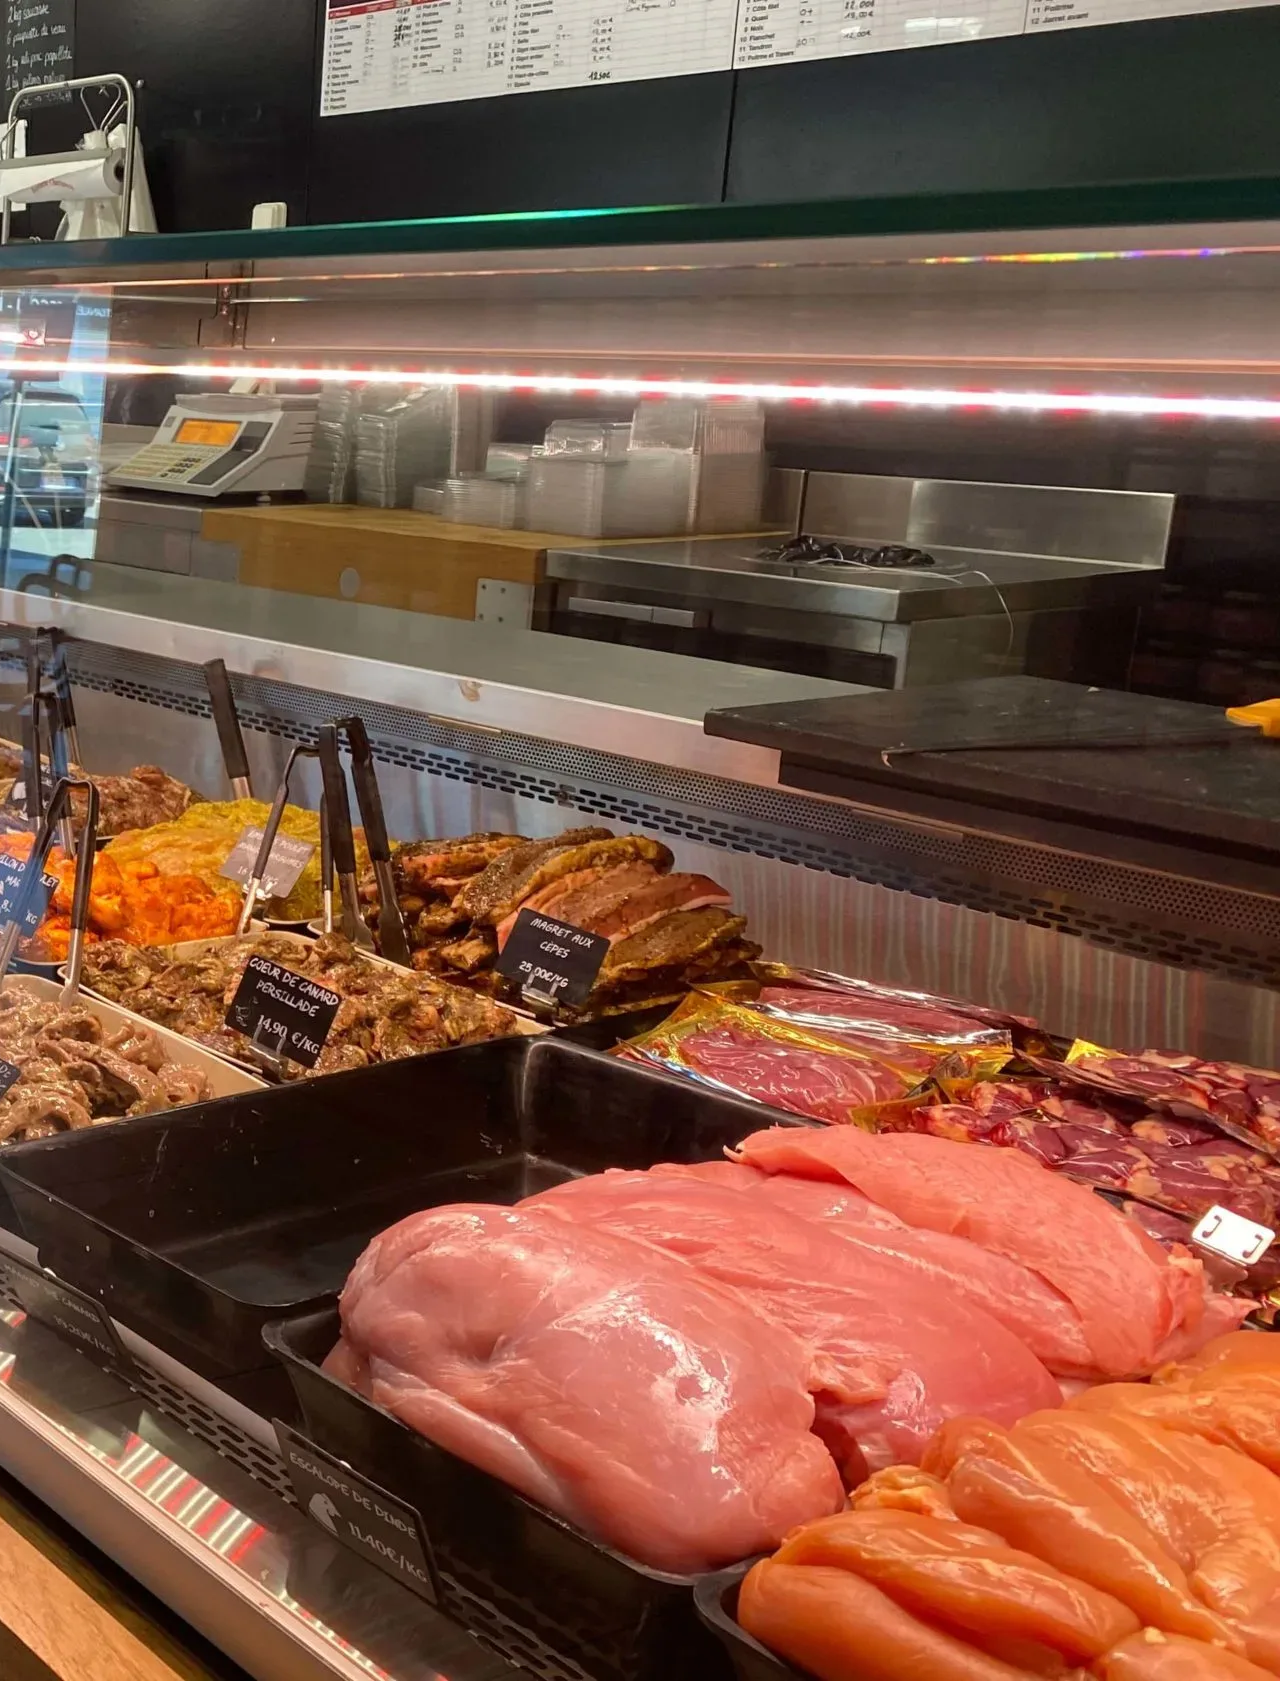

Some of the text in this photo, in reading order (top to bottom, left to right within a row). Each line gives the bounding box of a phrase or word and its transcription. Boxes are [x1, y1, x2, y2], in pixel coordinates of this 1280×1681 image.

[530, 918, 595, 949] MAGRET AUX
[249, 957, 339, 1006] COEUR DE CANARD
[256, 979, 320, 1017] PERSILLADE
[289, 1451, 417, 1540] ESCALOPE DE DINDE
